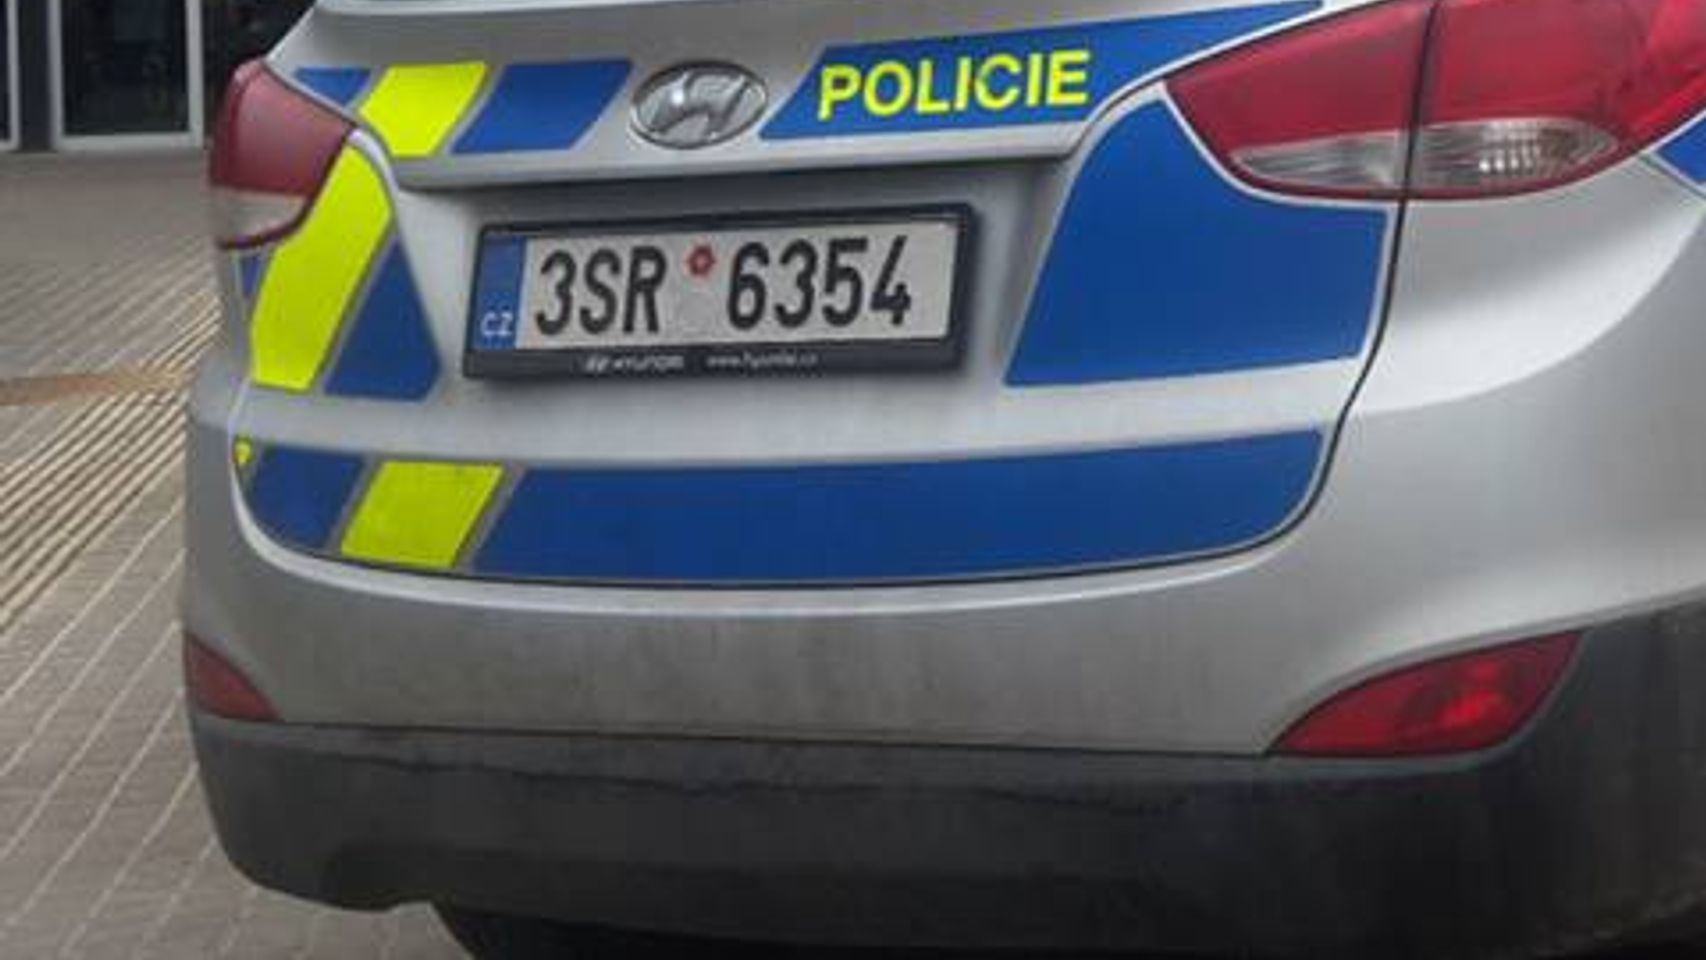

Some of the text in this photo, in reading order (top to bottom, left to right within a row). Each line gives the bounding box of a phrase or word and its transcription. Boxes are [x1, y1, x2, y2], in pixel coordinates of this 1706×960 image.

[817, 49, 1091, 123] POLICIE
[535, 234, 913, 337] 3SR 6354
[480, 312, 514, 338] CZ
